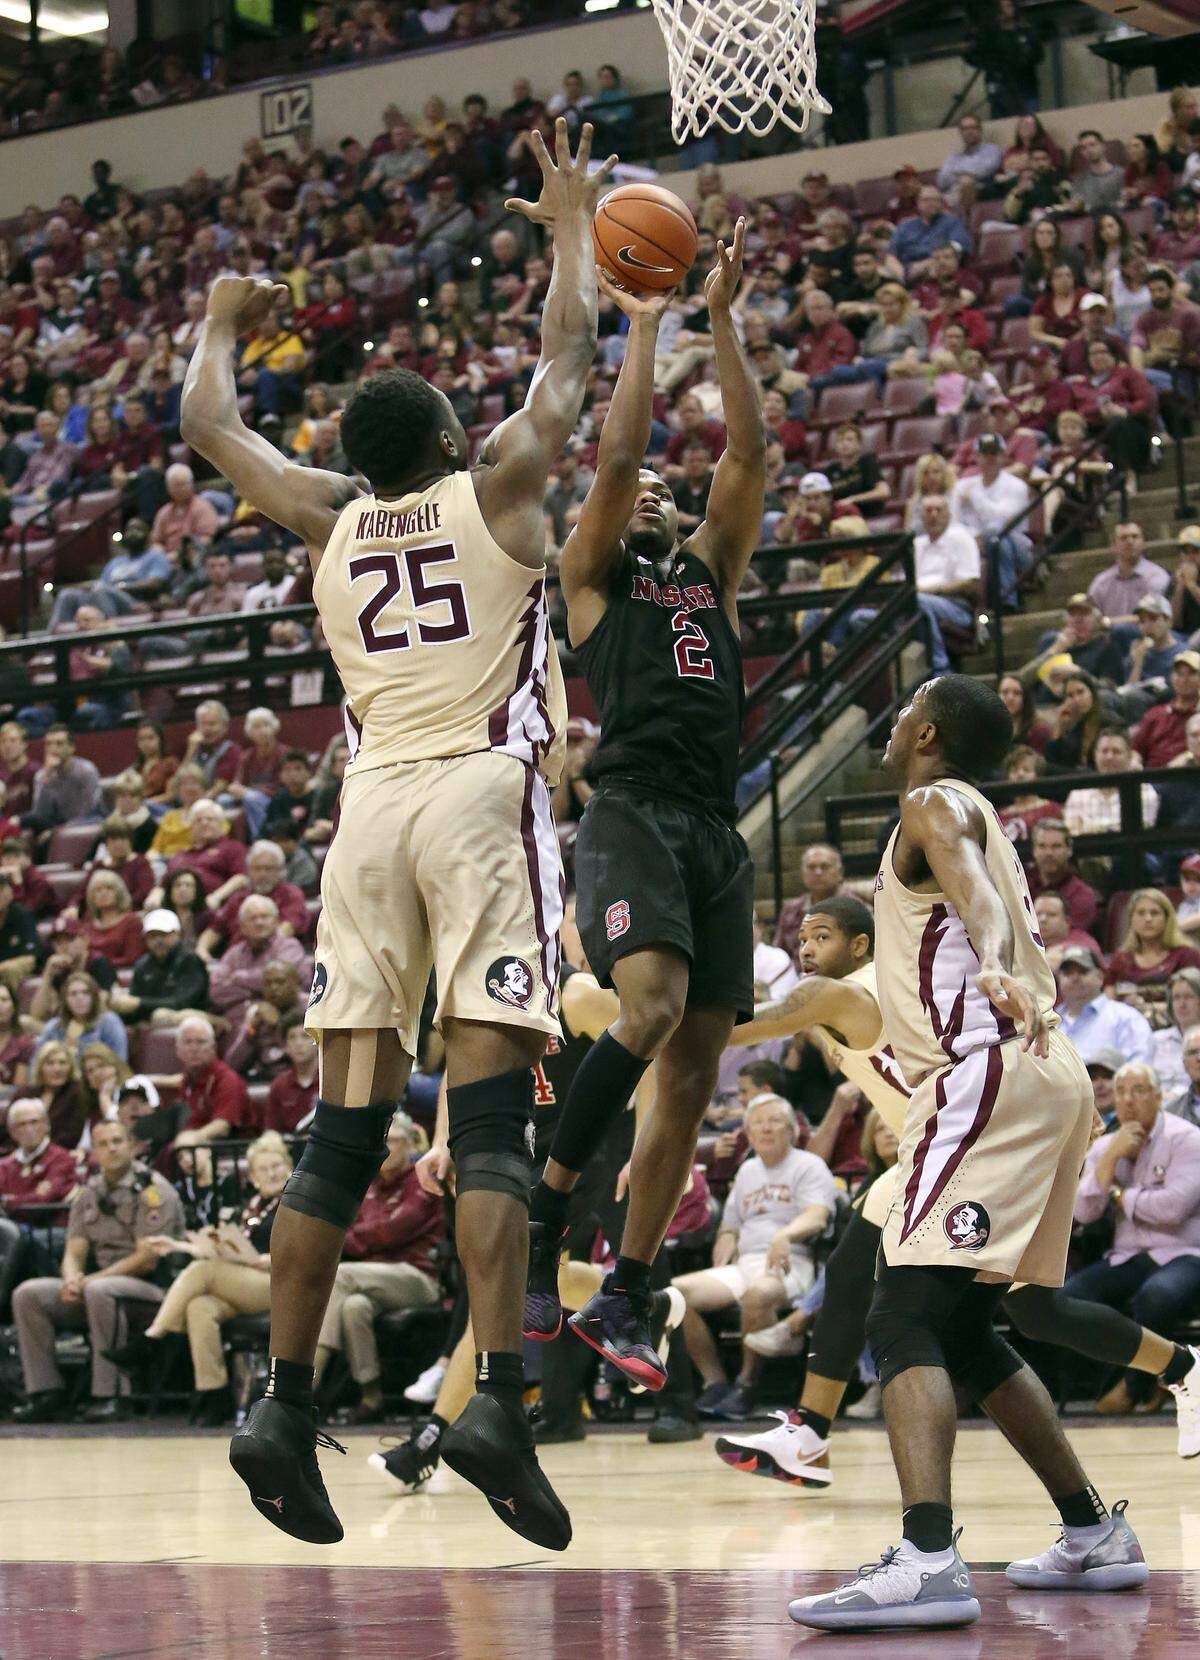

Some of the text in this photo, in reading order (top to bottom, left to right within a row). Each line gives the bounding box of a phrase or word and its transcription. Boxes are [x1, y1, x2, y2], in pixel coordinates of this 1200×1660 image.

[265, 89, 311, 134] 102
[356, 502, 442, 540] KABENGELE
[347, 540, 473, 656] 25
[671, 610, 715, 680] 2
